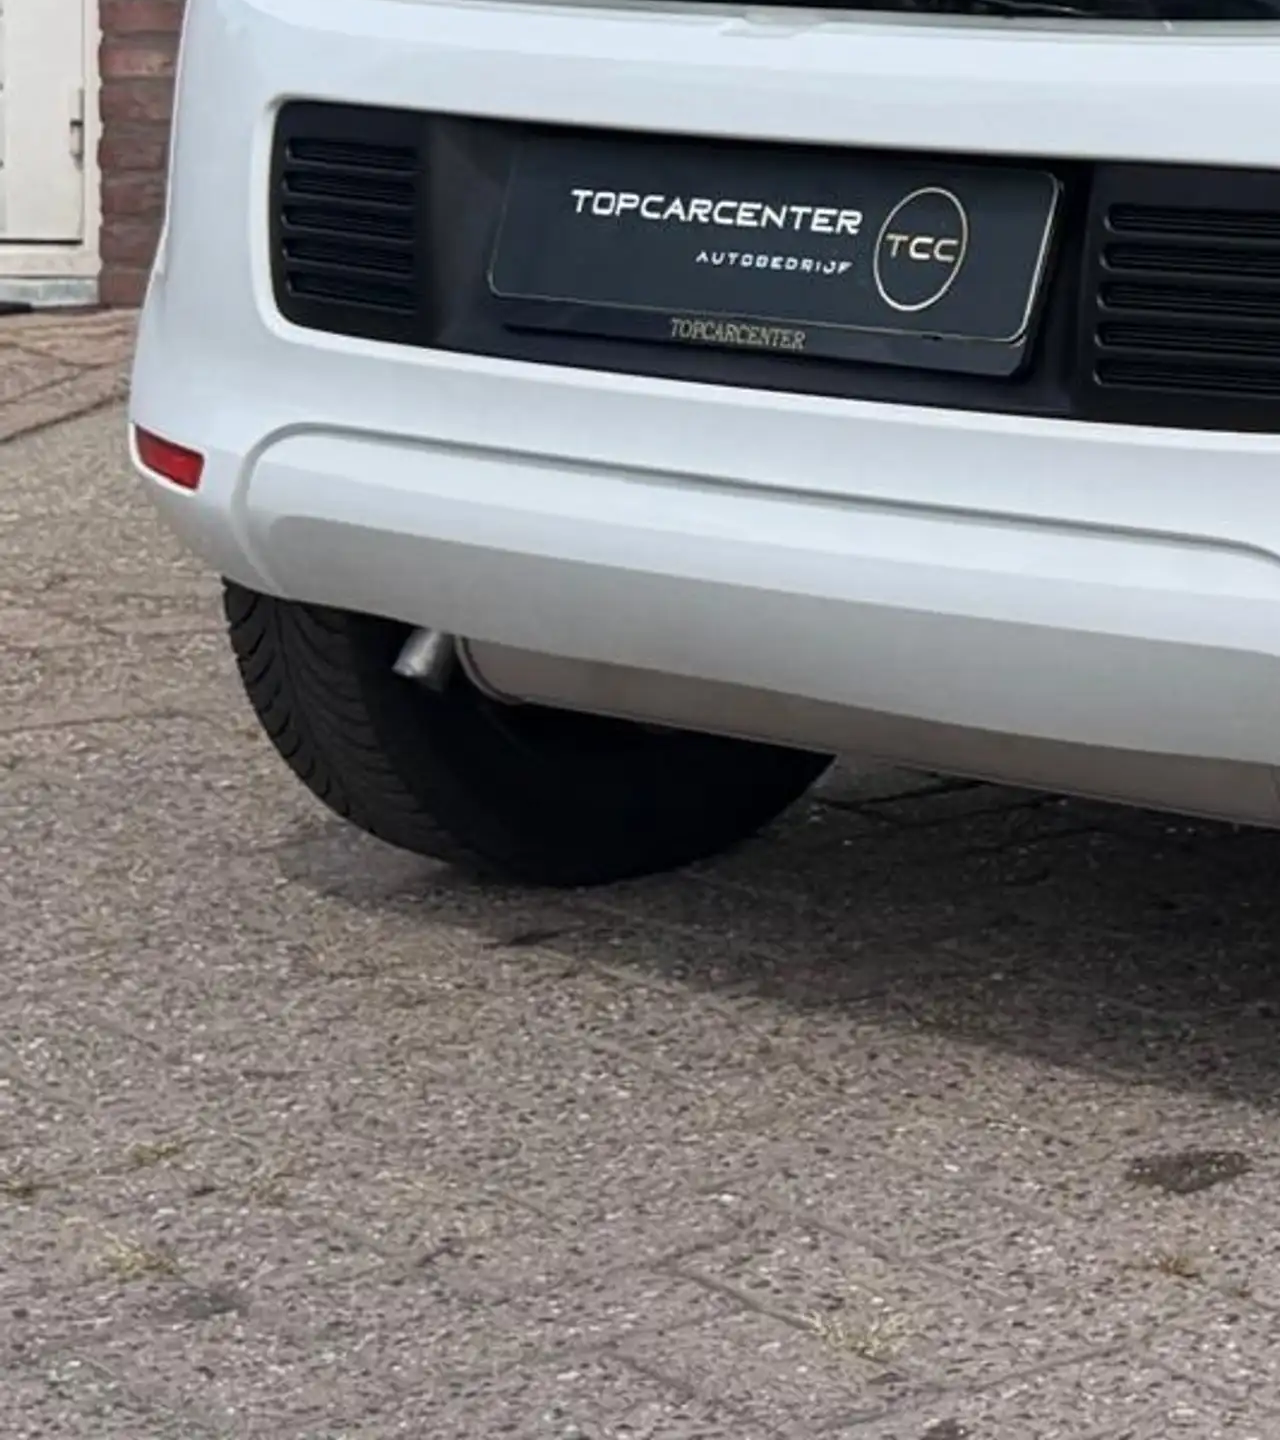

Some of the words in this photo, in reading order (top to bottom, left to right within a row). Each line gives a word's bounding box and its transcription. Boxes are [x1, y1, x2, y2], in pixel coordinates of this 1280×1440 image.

[572, 189, 862, 235] TOPCARCENTER
[695, 250, 852, 273] AUTOBEDRIJF
[885, 233, 959, 263] TCC
[670, 317, 806, 350] TOPCARCENTER
